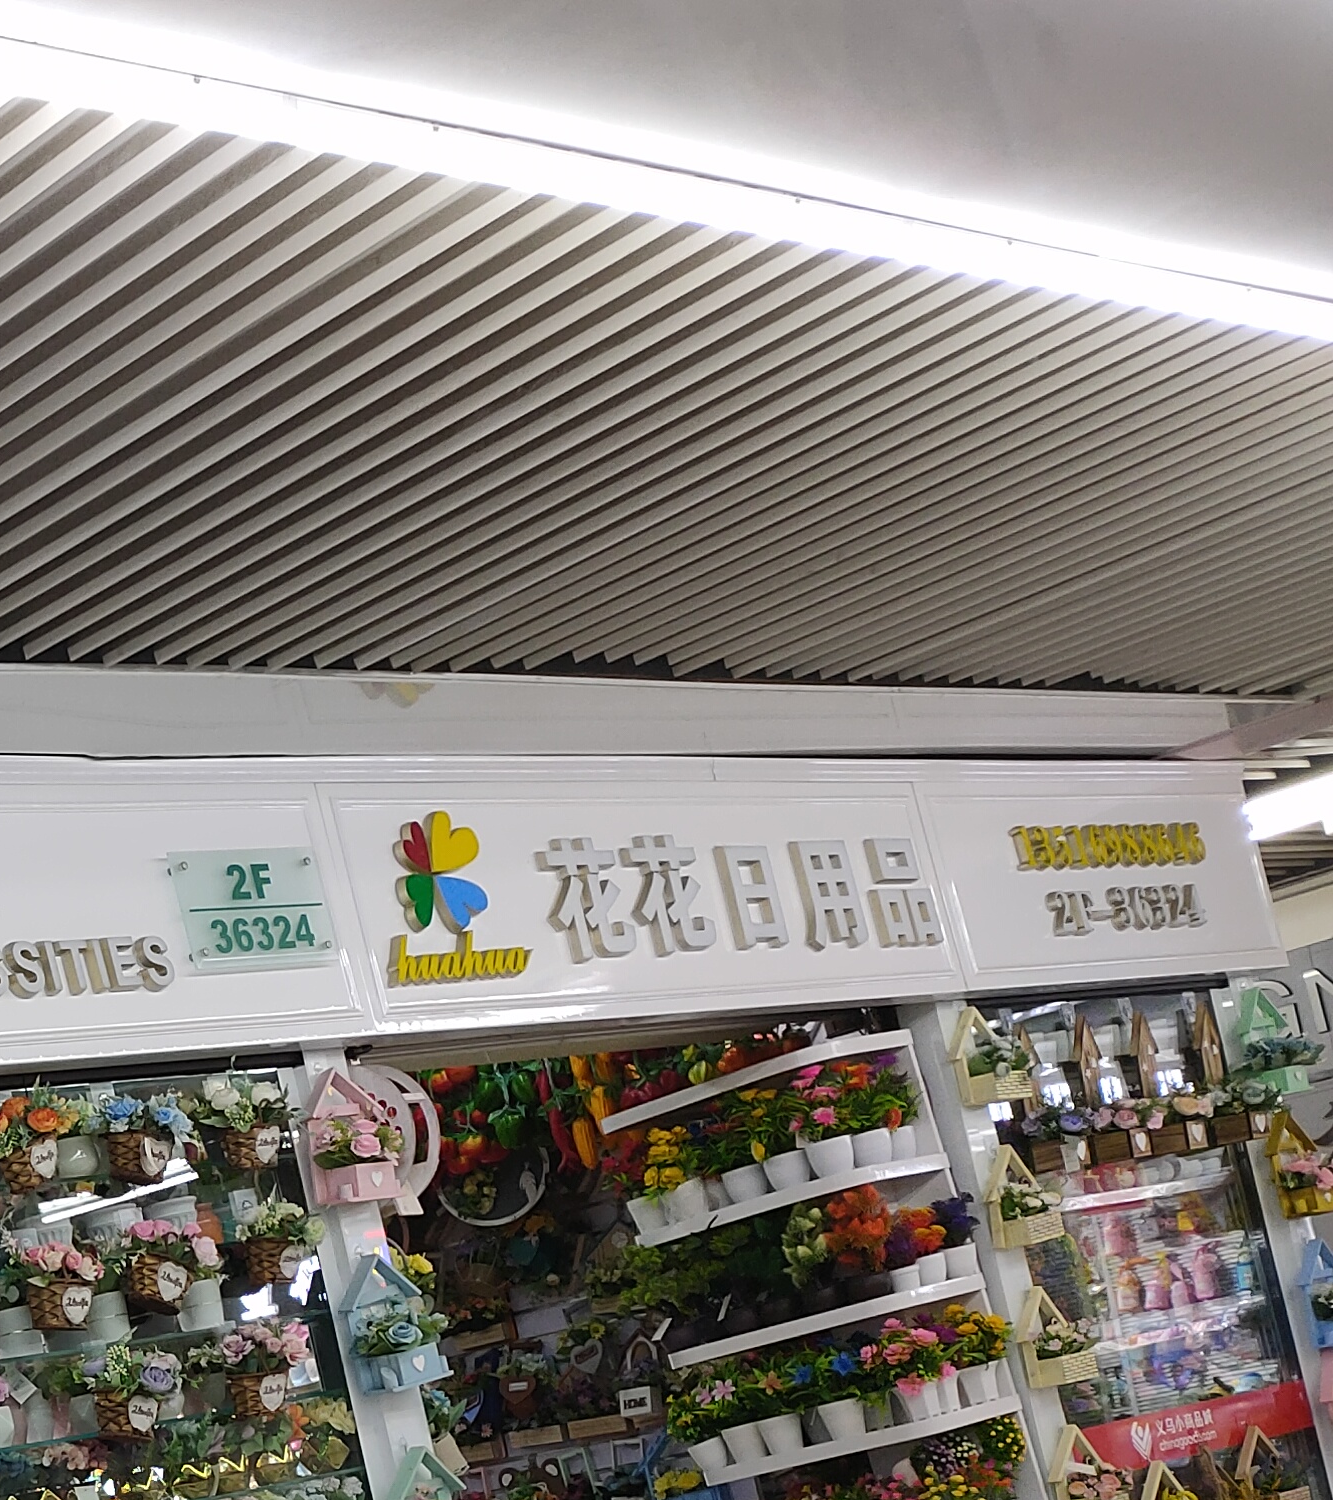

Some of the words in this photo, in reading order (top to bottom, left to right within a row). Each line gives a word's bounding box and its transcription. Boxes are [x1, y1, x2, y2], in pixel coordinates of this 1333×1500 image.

[226, 864, 272, 901] 2F
[534, 834, 943, 965] 花花日用品
[209, 914, 316, 954] 36324
[388, 929, 534, 989] huahua
